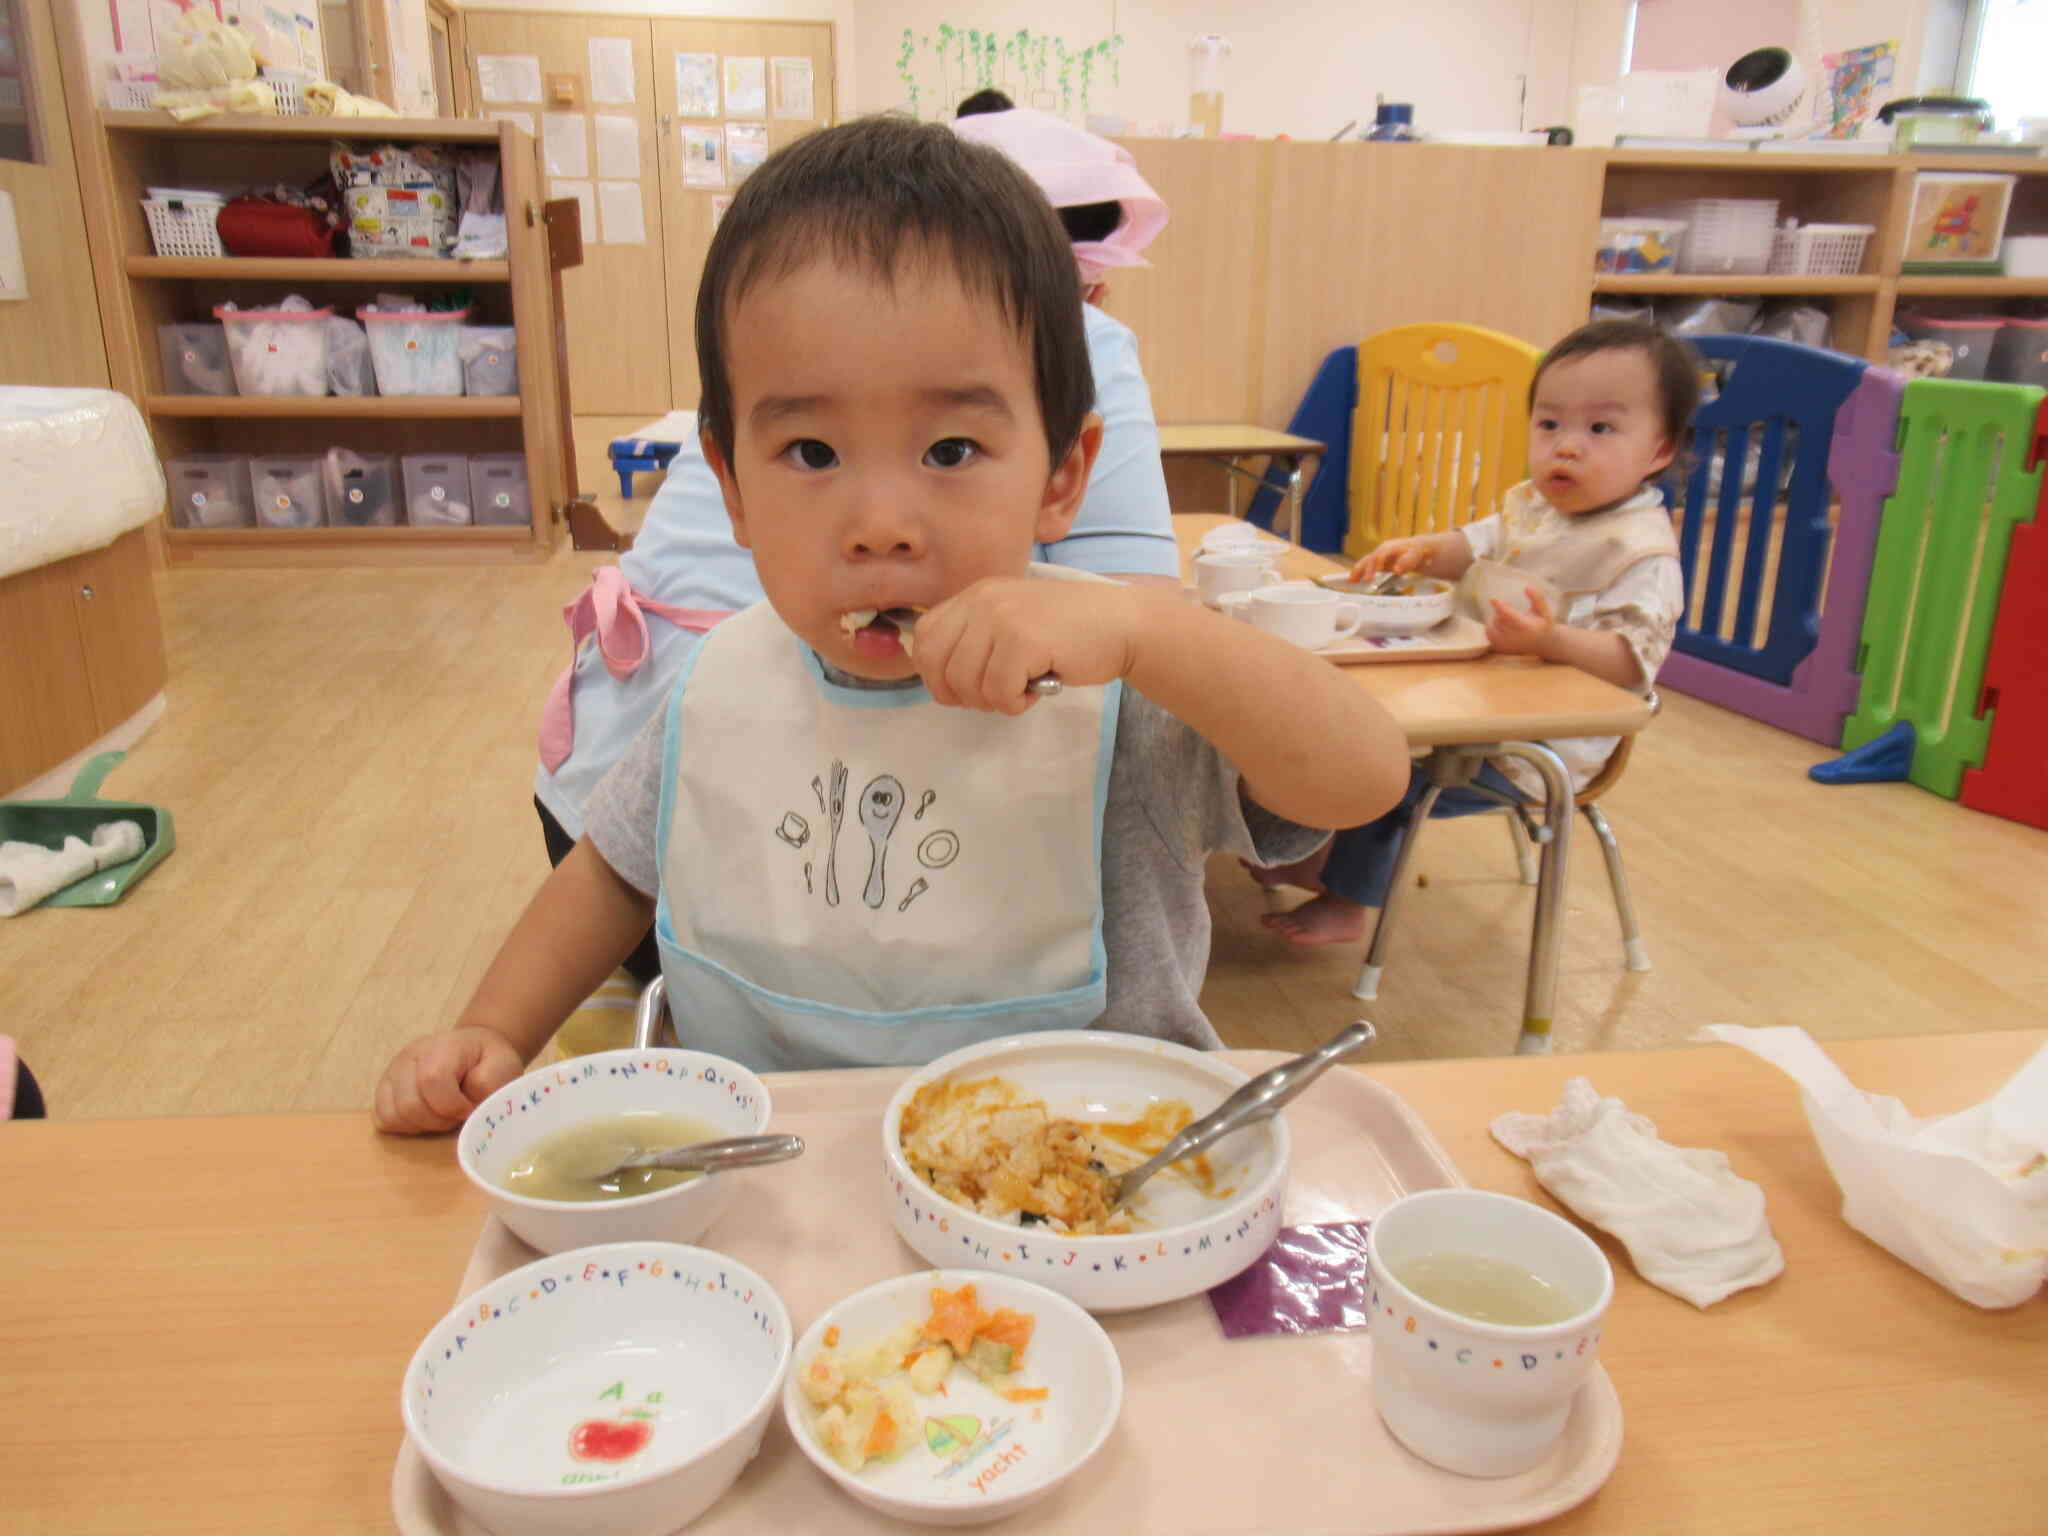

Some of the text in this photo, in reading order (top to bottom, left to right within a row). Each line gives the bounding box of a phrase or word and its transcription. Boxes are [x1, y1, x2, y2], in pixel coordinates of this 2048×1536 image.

[705, 1068, 717, 1083] Q
[1063, 1252, 1077, 1266] J
[1114, 1256, 1128, 1271] K
[541, 1278, 557, 1293] D
[583, 1263, 598, 1281] E
[618, 1269, 629, 1288] F
[651, 1260, 664, 1277] G
[1456, 1348, 1473, 1365] C
[1521, 1354, 1538, 1370] D
[598, 1381, 625, 1401] A
[967, 1441, 1028, 1497] yacht
